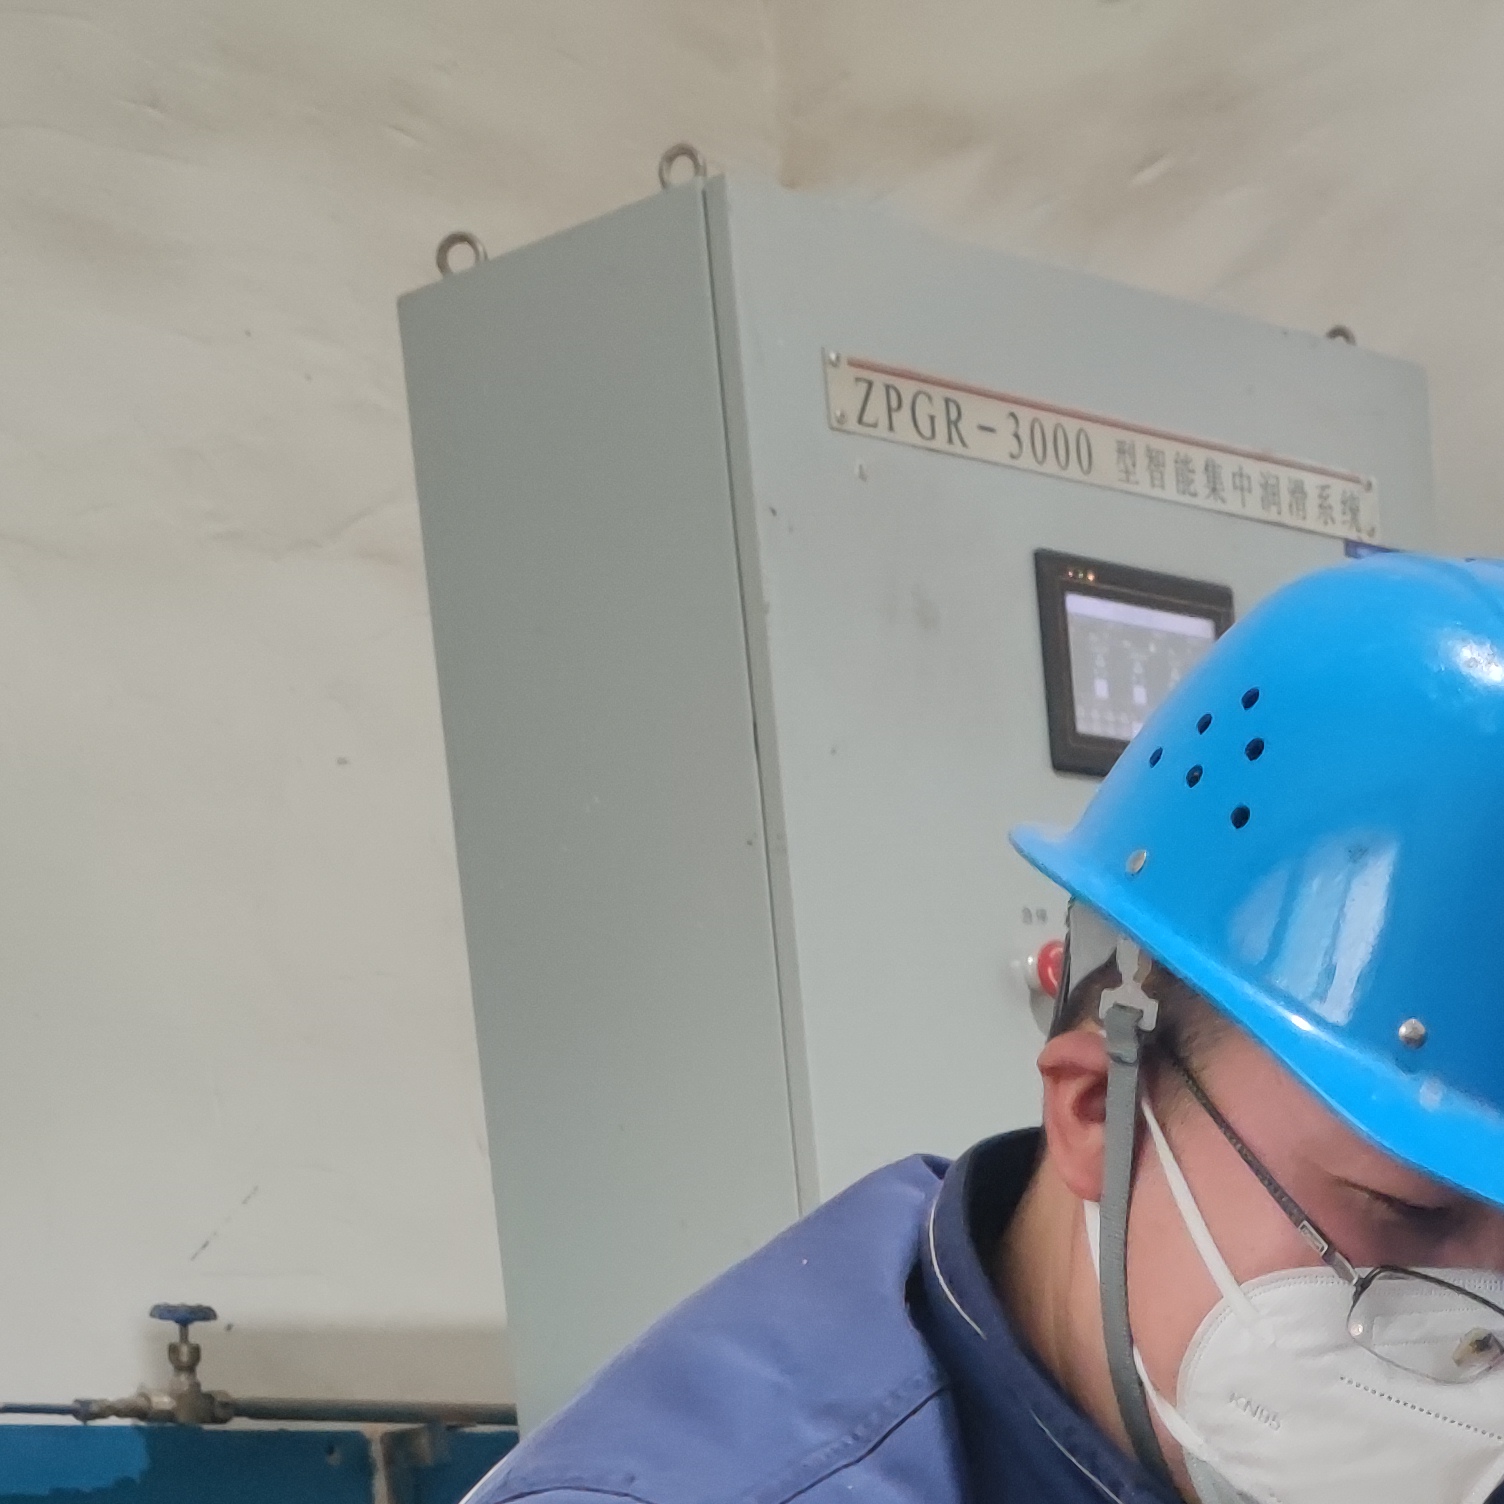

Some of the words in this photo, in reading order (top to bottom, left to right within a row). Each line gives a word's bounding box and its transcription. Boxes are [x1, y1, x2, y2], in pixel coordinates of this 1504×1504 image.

[853, 376, 1094, 477] ZPGR-3000
[1115, 438, 1364, 532] 型智能集中润滑系统
